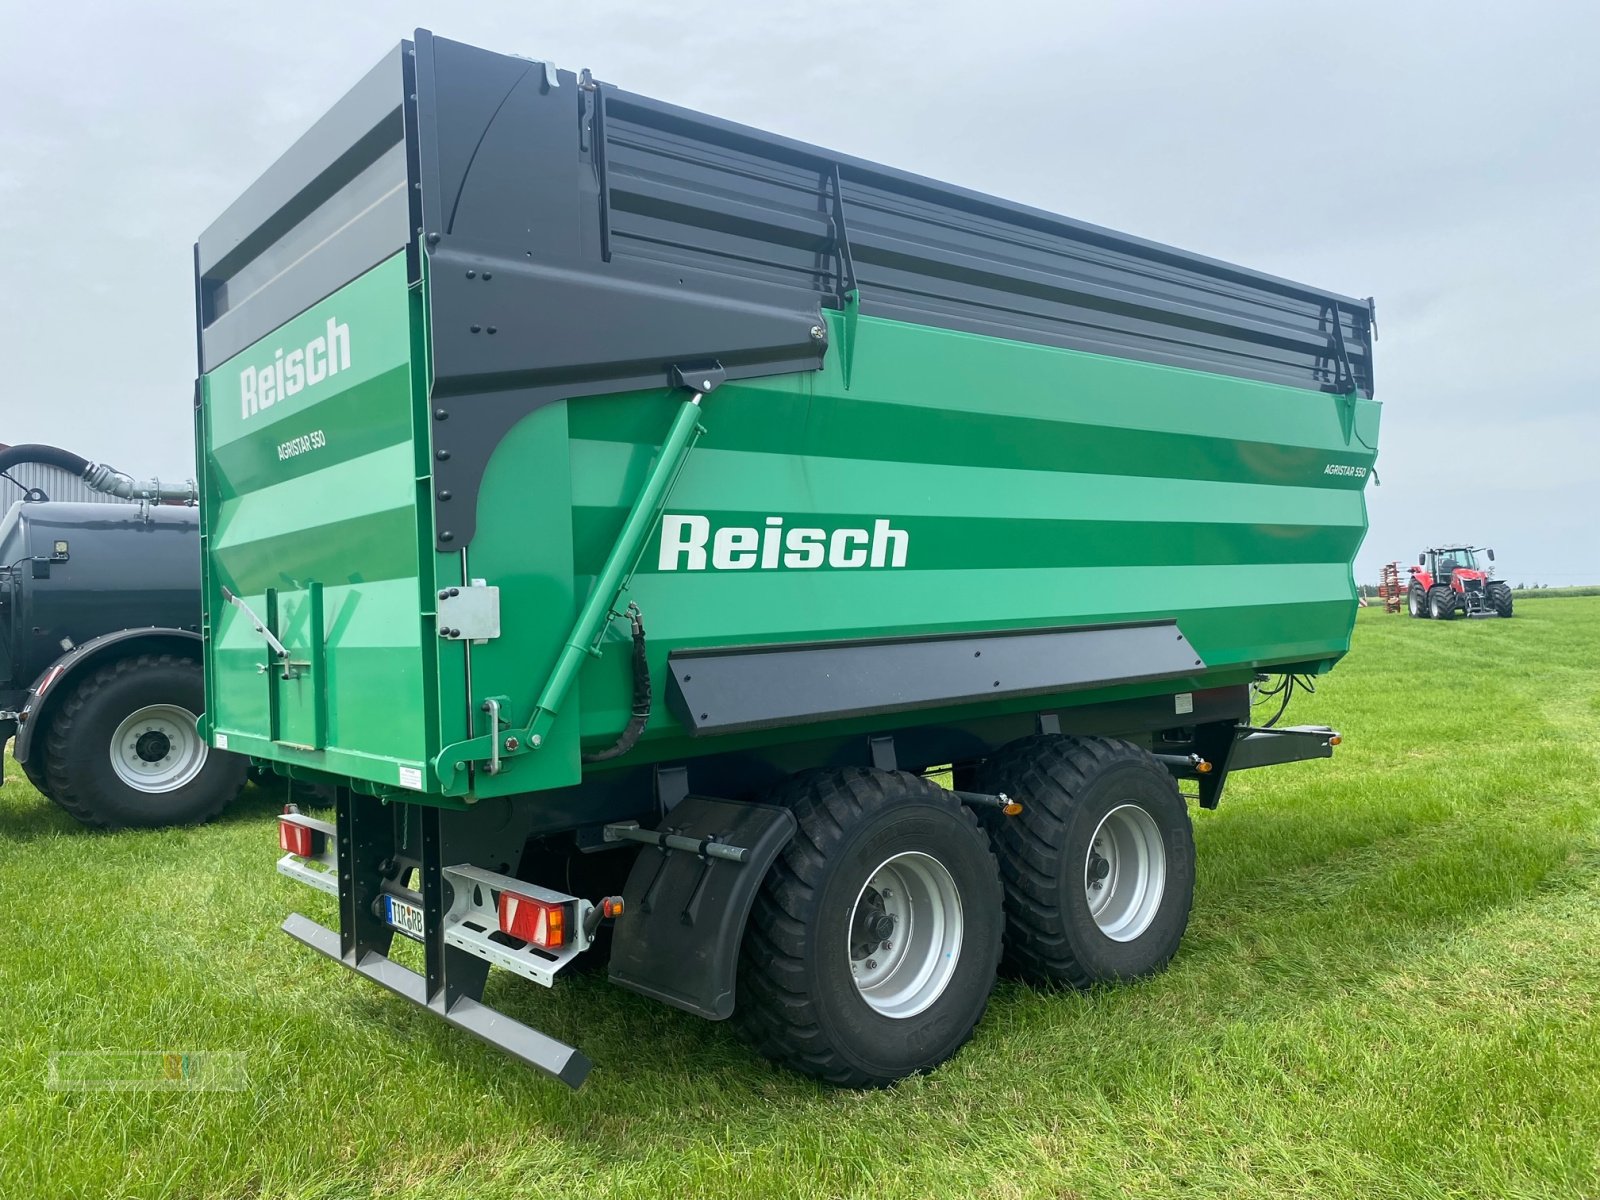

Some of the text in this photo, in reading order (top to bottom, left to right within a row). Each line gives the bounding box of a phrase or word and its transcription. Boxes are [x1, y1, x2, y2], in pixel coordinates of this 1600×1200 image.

[240, 316, 351, 420] Reisch
[277, 430, 326, 461] AGRISTAR 550
[1324, 464, 1366, 477] AGRISTAR 550
[658, 514, 909, 570] Reisch
